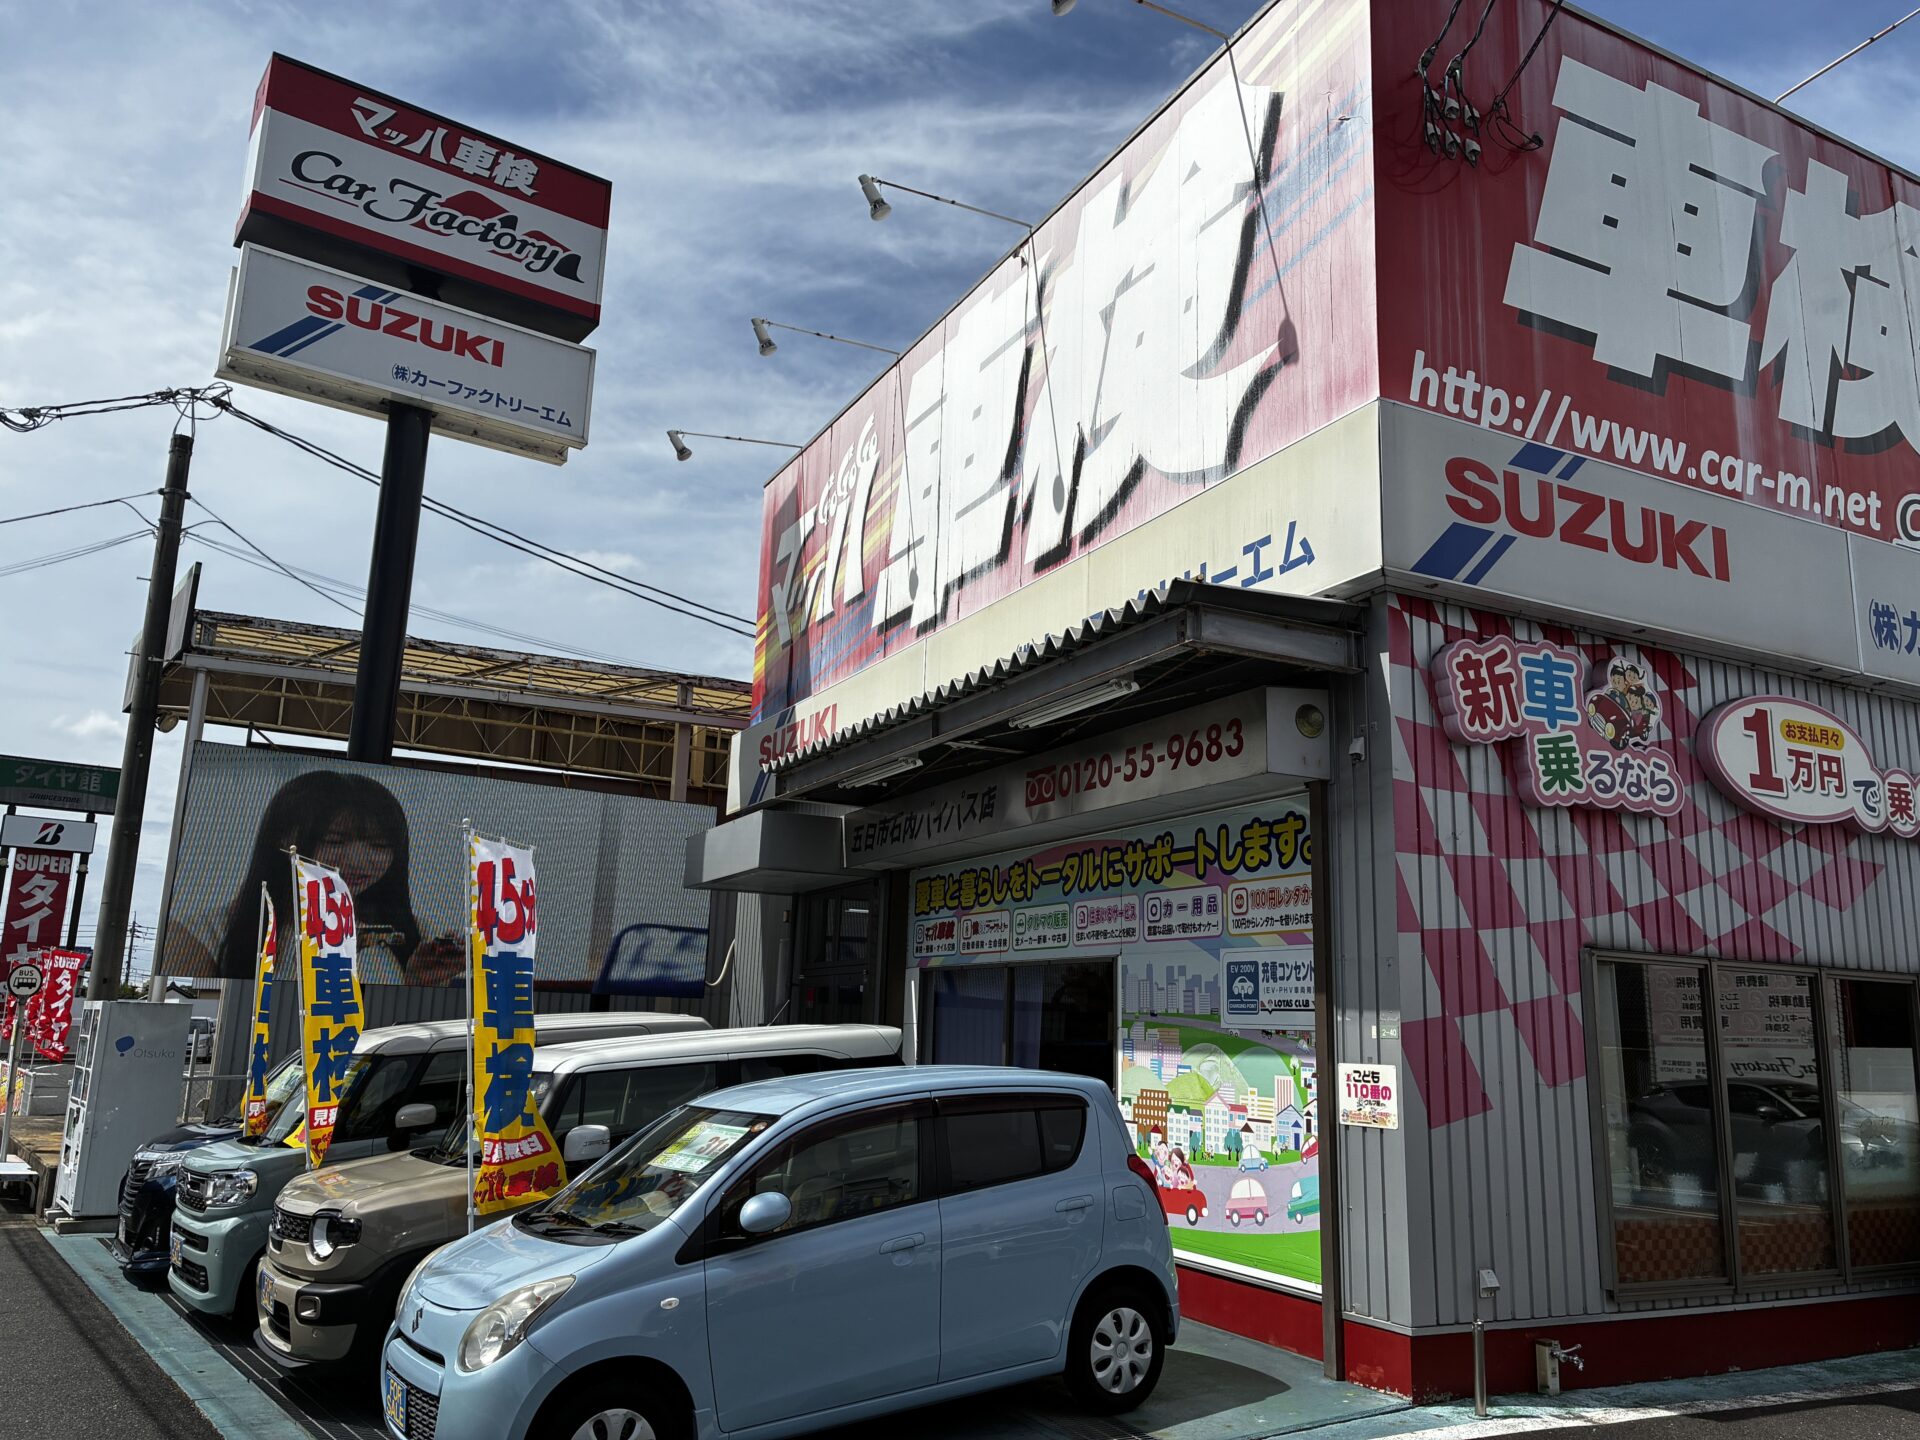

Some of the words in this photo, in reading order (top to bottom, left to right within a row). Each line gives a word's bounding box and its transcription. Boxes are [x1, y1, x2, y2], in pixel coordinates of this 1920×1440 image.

[350, 96, 540, 198] マッハ車検
[290, 150, 377, 202] Car
[362, 178, 570, 276] Factory
[305, 285, 505, 368] SUZUKI
[1408, 349, 1882, 532] http://www.car-m.net
[1445, 456, 1732, 583] SUZUKI
[1454, 647, 1580, 731] 新車
[758, 702, 838, 767] SUZUKI
[1057, 717, 1245, 799] 0120-55-9683
[1784, 723, 1842, 747] お支払月々
[15, 764, 103, 792] タイヤ館
[1536, 733, 1677, 803] 乗るなら
[15, 853, 71, 874] SUPER
[18, 969, 34, 977] BUS
[53, 955, 80, 971] SUPER
[1274, 999, 1293, 1008] LOTAS
[1295, 999, 1310, 1008] CLUB
[1381, 1028, 1398, 1037] 2-40
[480, 950, 536, 1135] 車検
[1345, 1084, 1392, 1101] 110番の
[1353, 1069, 1380, 1084] こども
